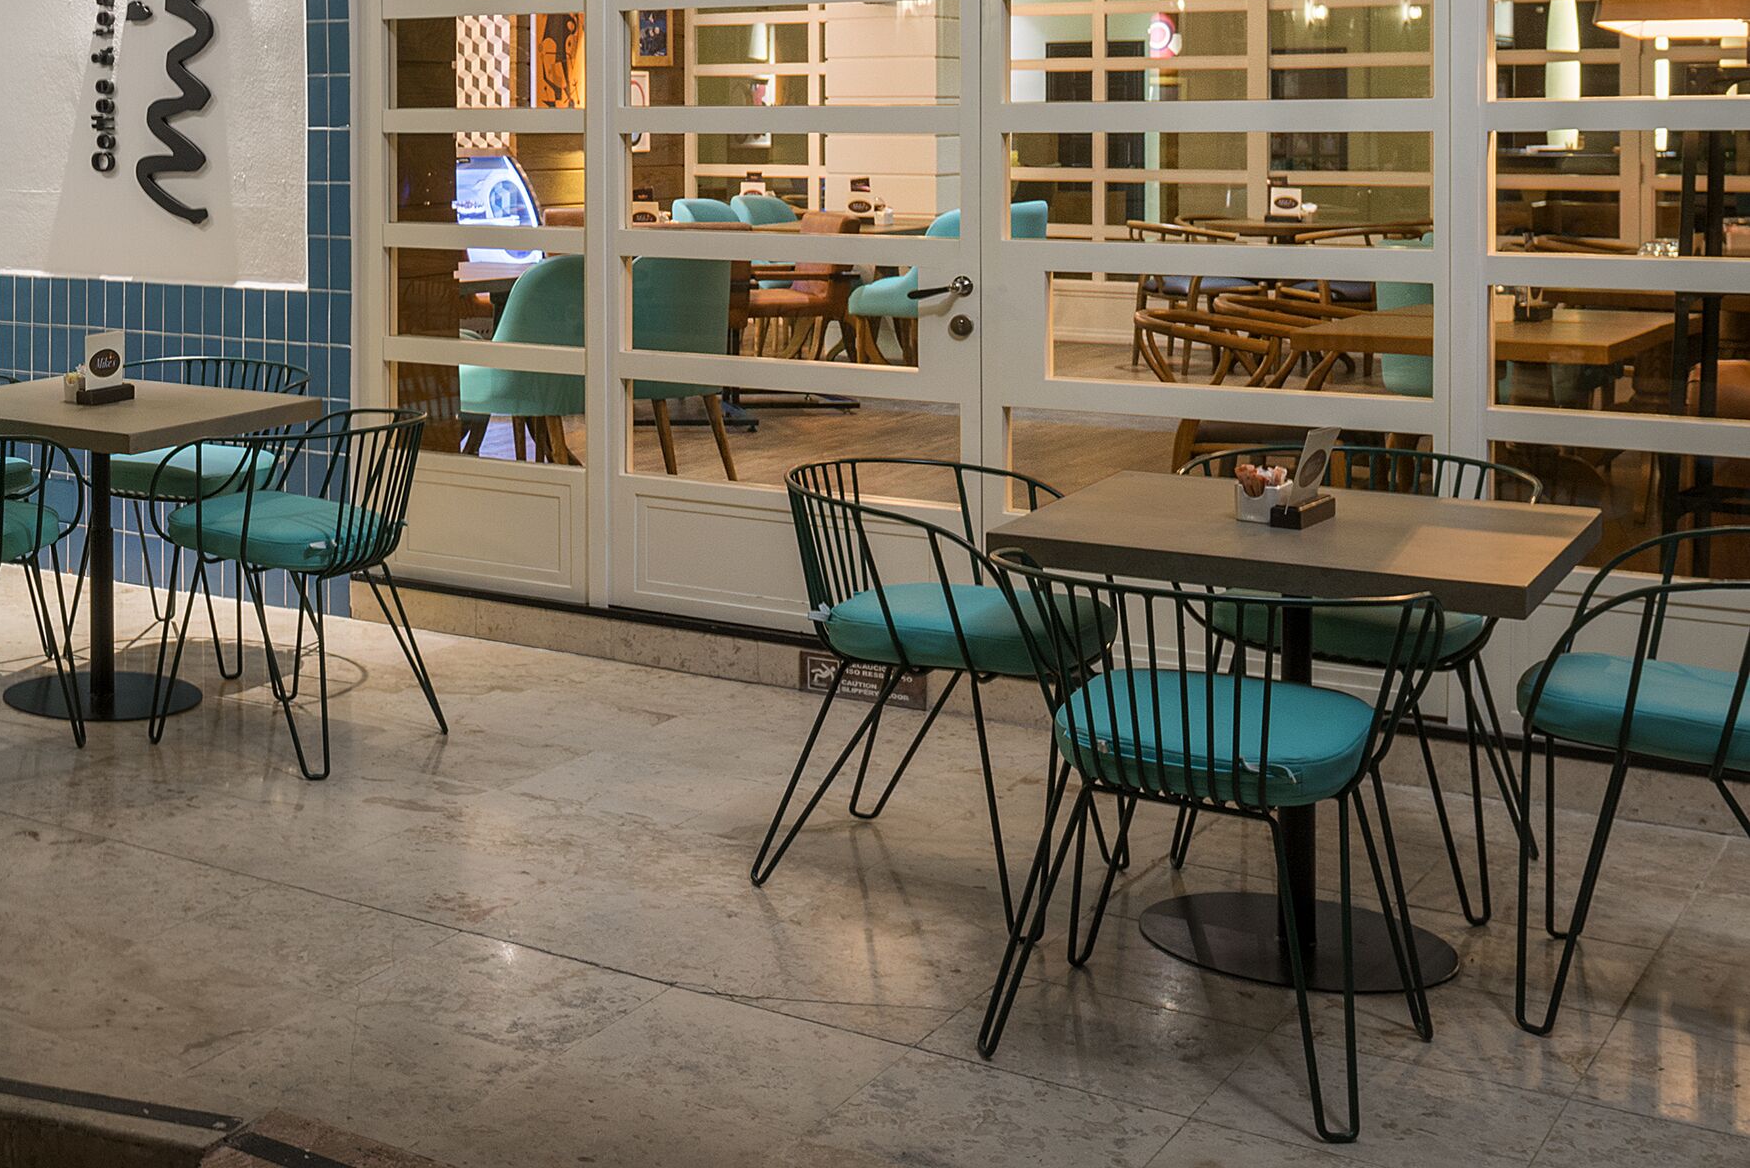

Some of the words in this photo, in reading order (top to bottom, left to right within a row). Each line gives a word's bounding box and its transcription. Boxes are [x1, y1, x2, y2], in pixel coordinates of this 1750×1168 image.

[91, 47, 115, 66] &
[91, 79, 116, 172] Coffee
[844, 668, 861, 676] ISO
[862, 670, 913, 683] RESBSO
[841, 679, 877, 689] CAUTION
[841, 686, 880, 697] SLIPPERY
[887, 692, 909, 701] OOR
